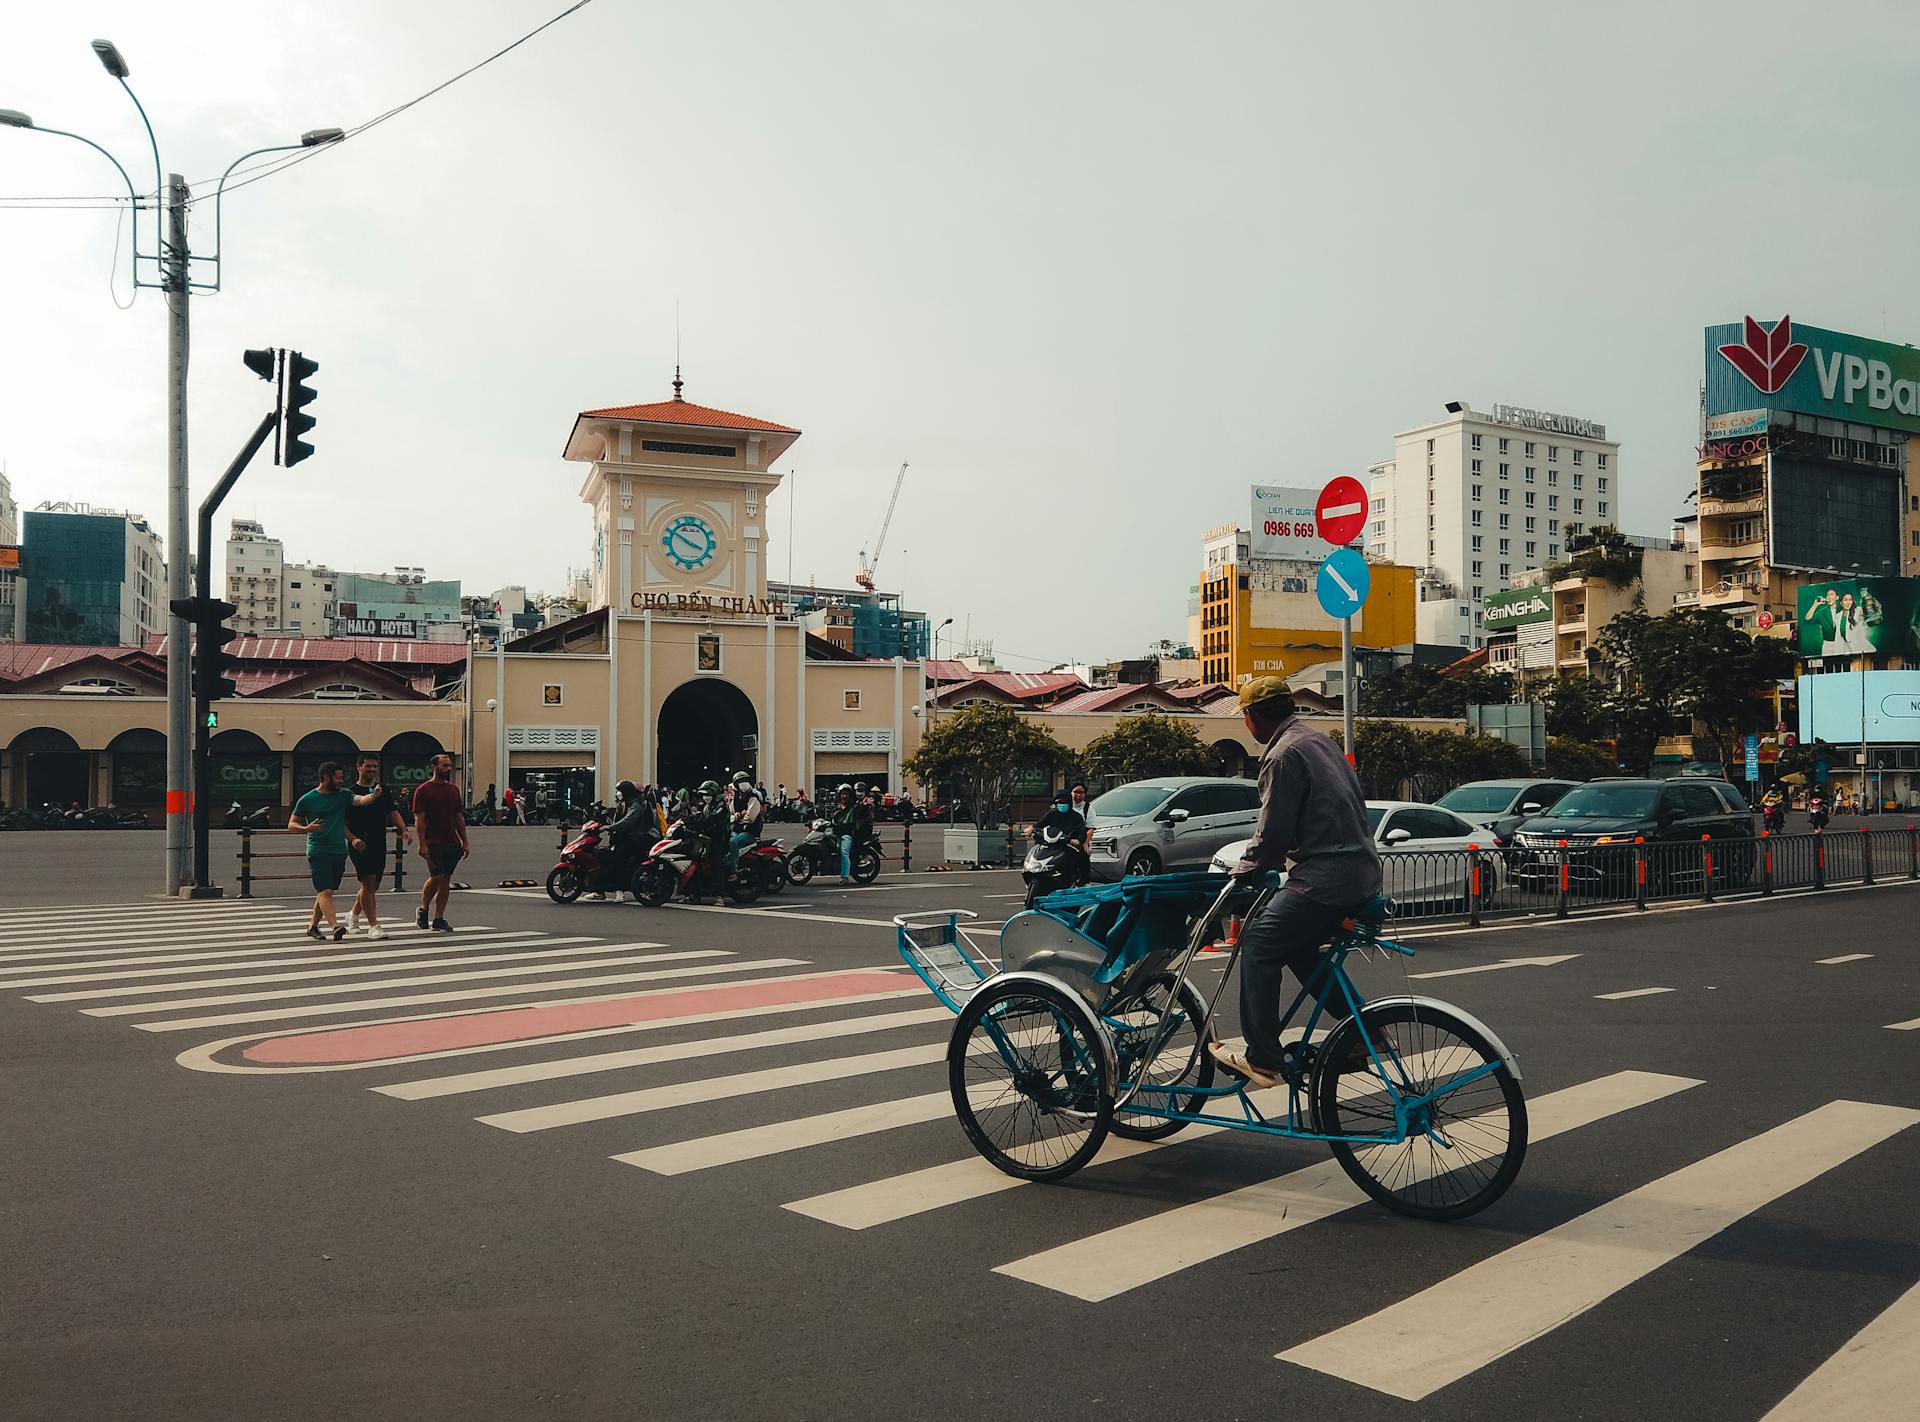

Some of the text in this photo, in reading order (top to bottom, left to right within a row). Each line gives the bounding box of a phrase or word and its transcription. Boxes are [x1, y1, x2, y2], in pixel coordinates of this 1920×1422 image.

[1813, 347, 1920, 417] VPBa
[34, 500, 90, 513] AVANTI
[1264, 520, 1314, 538] 0986 669
[631, 592, 670, 611] CHỢ
[676, 590, 712, 612] BẾN
[348, 619, 415, 636] HALO HOTEL
[221, 765, 269, 781] Grab
